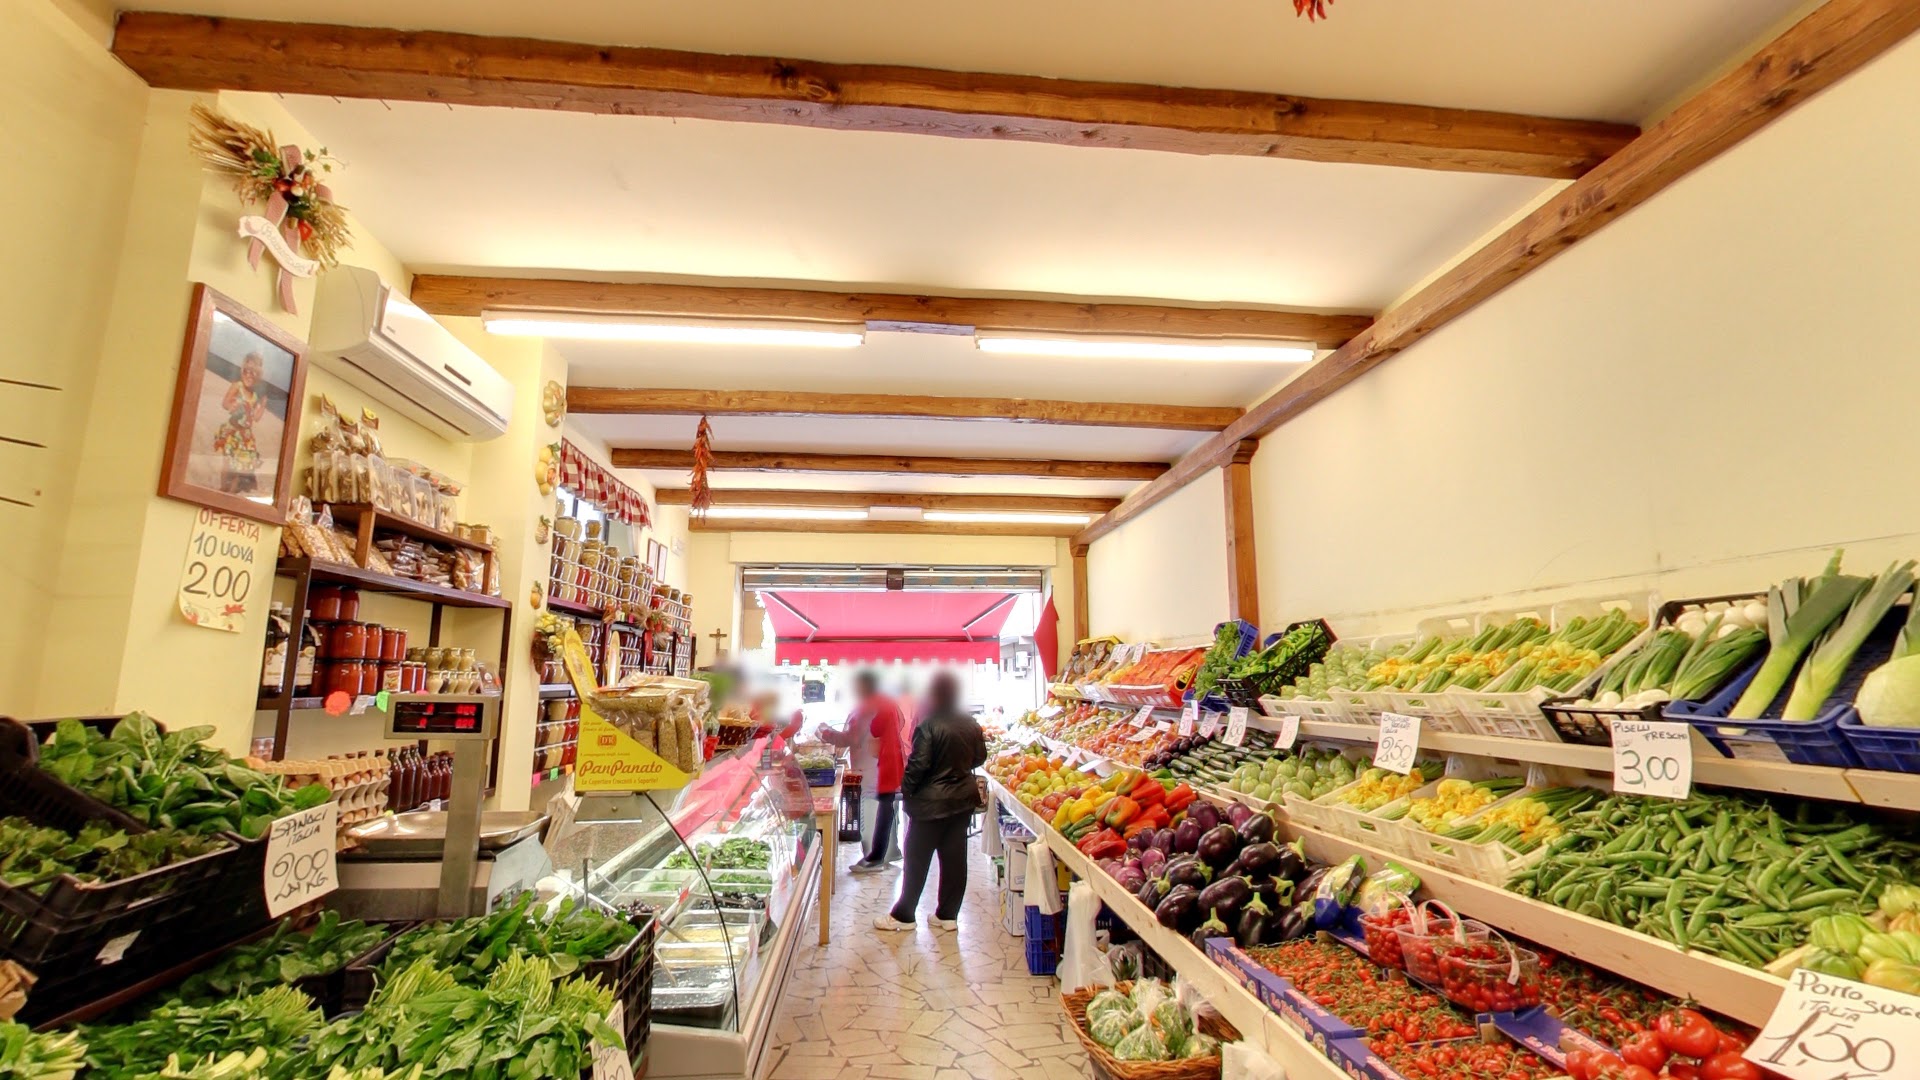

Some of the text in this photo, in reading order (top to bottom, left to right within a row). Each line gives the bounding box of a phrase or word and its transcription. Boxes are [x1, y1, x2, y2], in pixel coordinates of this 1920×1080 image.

[199, 508, 260, 542] OFFERTA
[194, 531, 254, 564] 10 UOVA
[183, 561, 250, 602] 2,00
[1612, 721, 1650, 733] PISELLI
[580, 760, 662, 777] PanPanato
[1620, 749, 1680, 788] 3,00
[271, 808, 328, 841] SPINACI
[1799, 1000, 1860, 1022] ITALIA
[1759, 1010, 1895, 1073] 1,50
